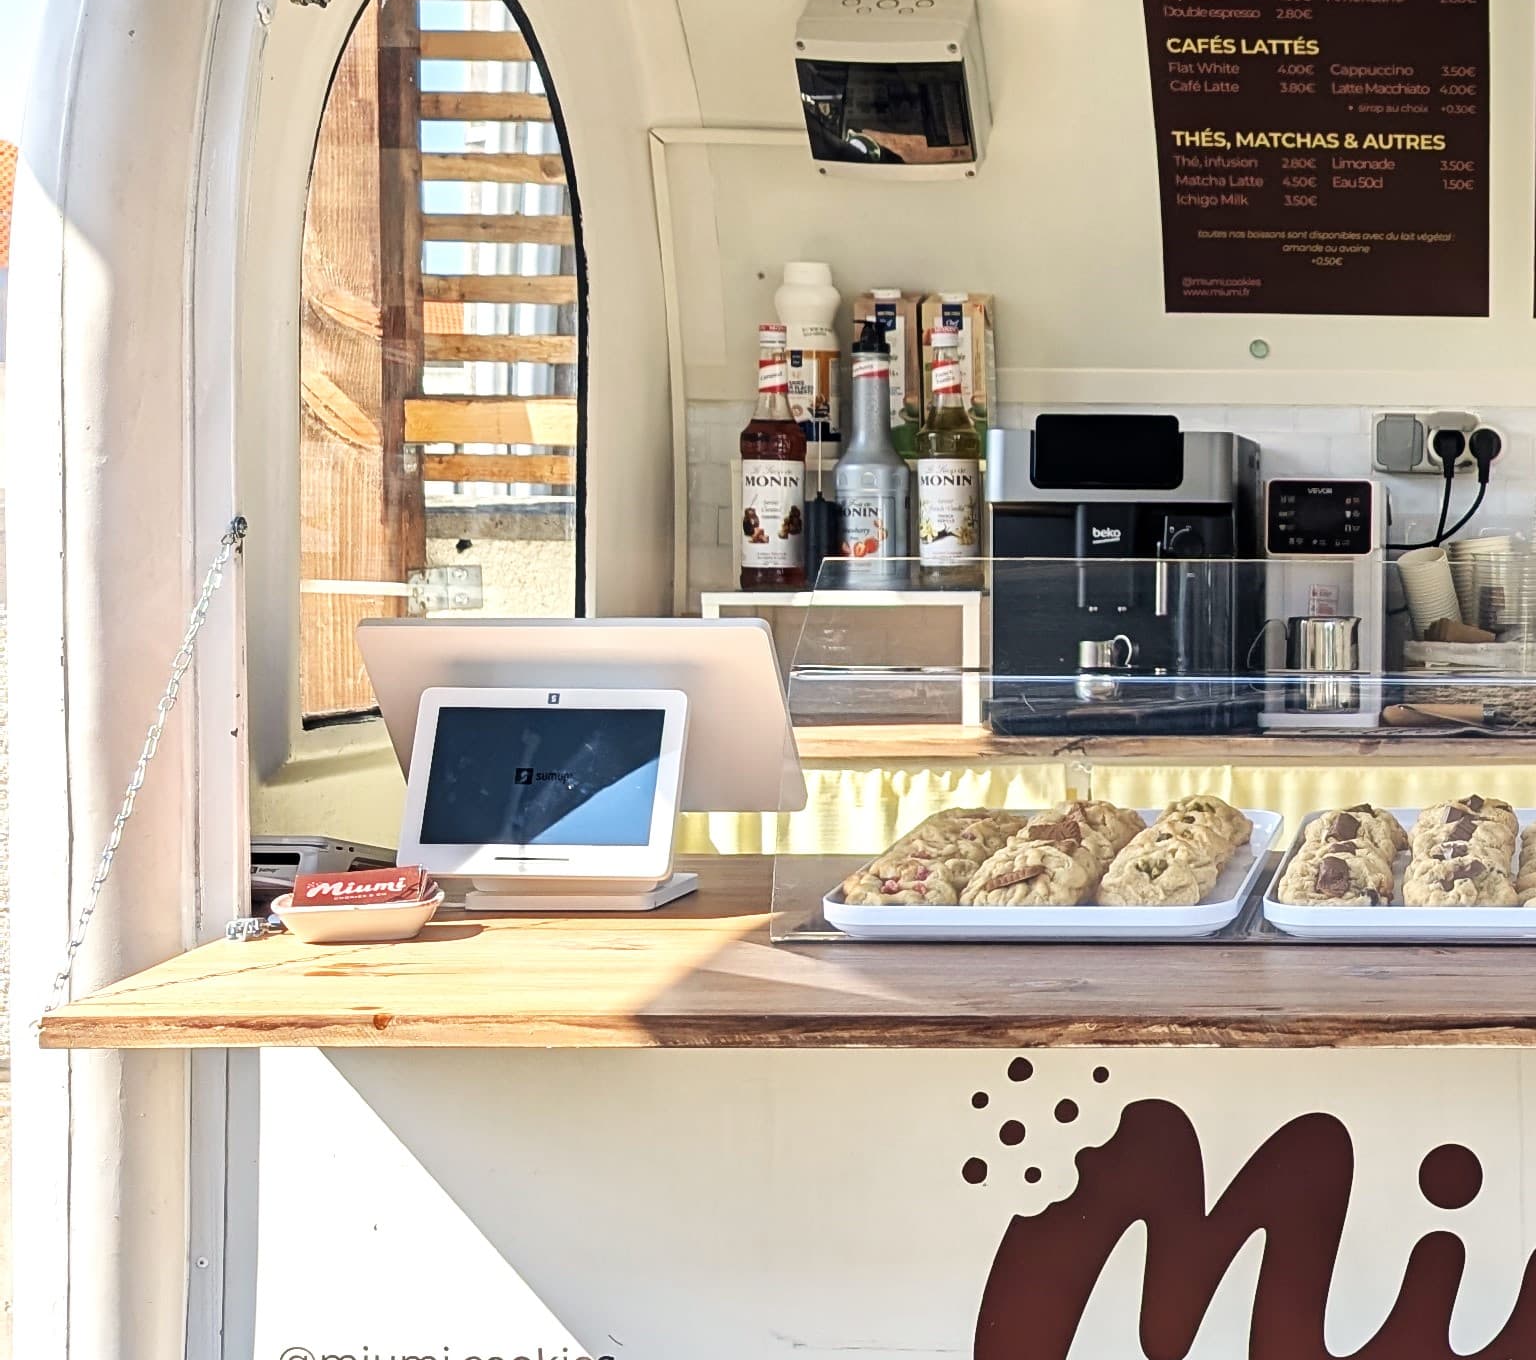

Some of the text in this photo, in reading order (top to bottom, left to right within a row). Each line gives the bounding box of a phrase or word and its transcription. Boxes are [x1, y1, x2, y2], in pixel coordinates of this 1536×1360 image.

[1167, 35, 1319, 55] CAFÉS LATTÉS
[1168, 62, 1239, 74] Flat White
[1330, 64, 1414, 77] Cappuccino
[1170, 80, 1239, 92] Café Latte
[1332, 83, 1430, 95] Latte Macchiato
[1172, 128, 1445, 150] THÉS, MATCHAS & AUTRES
[1204, 156, 1258, 168] infusion
[1332, 158, 1395, 169] Limonade
[1176, 174, 1263, 187] Matcha Latte
[1333, 176, 1357, 188] Eau
[1177, 194, 1248, 208] Ichigo Milk
[745, 475, 799, 487] MONIN
[920, 475, 972, 486] MONIN
[841, 506, 879, 517] ONIN
[1092, 527, 1121, 538] beko
[306, 877, 406, 898] Miumi
